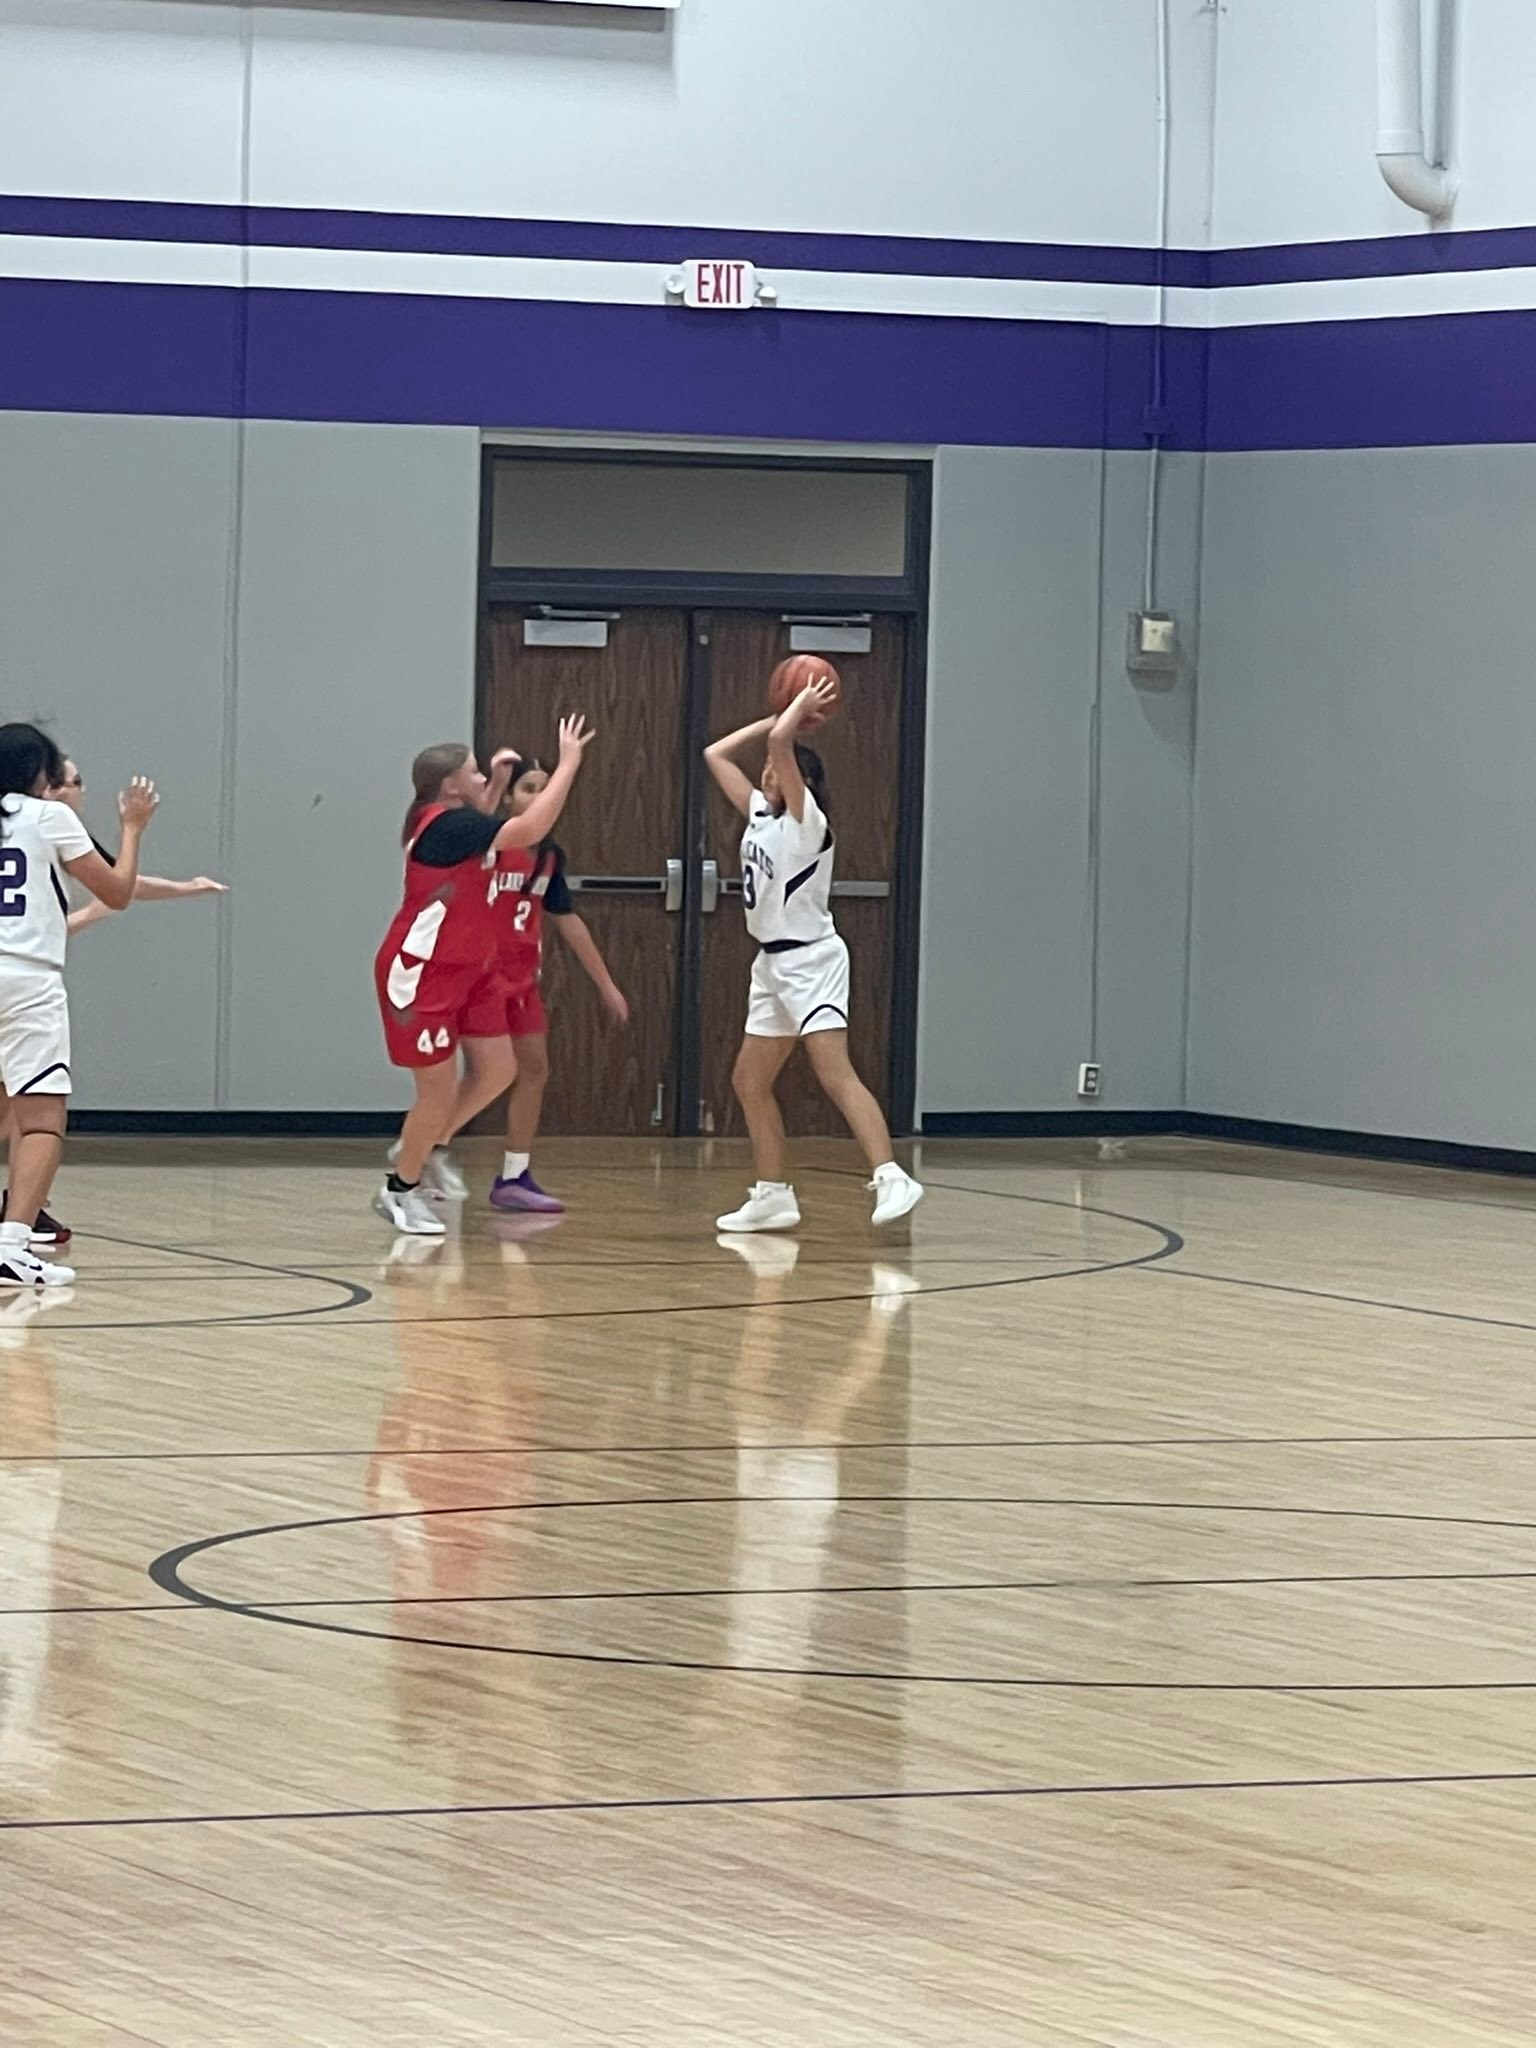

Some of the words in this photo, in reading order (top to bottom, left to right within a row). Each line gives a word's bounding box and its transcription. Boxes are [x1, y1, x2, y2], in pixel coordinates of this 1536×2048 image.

[697, 264, 745, 304] EXIT
[513, 900, 532, 932] 2
[416, 1027, 450, 1055] 44
